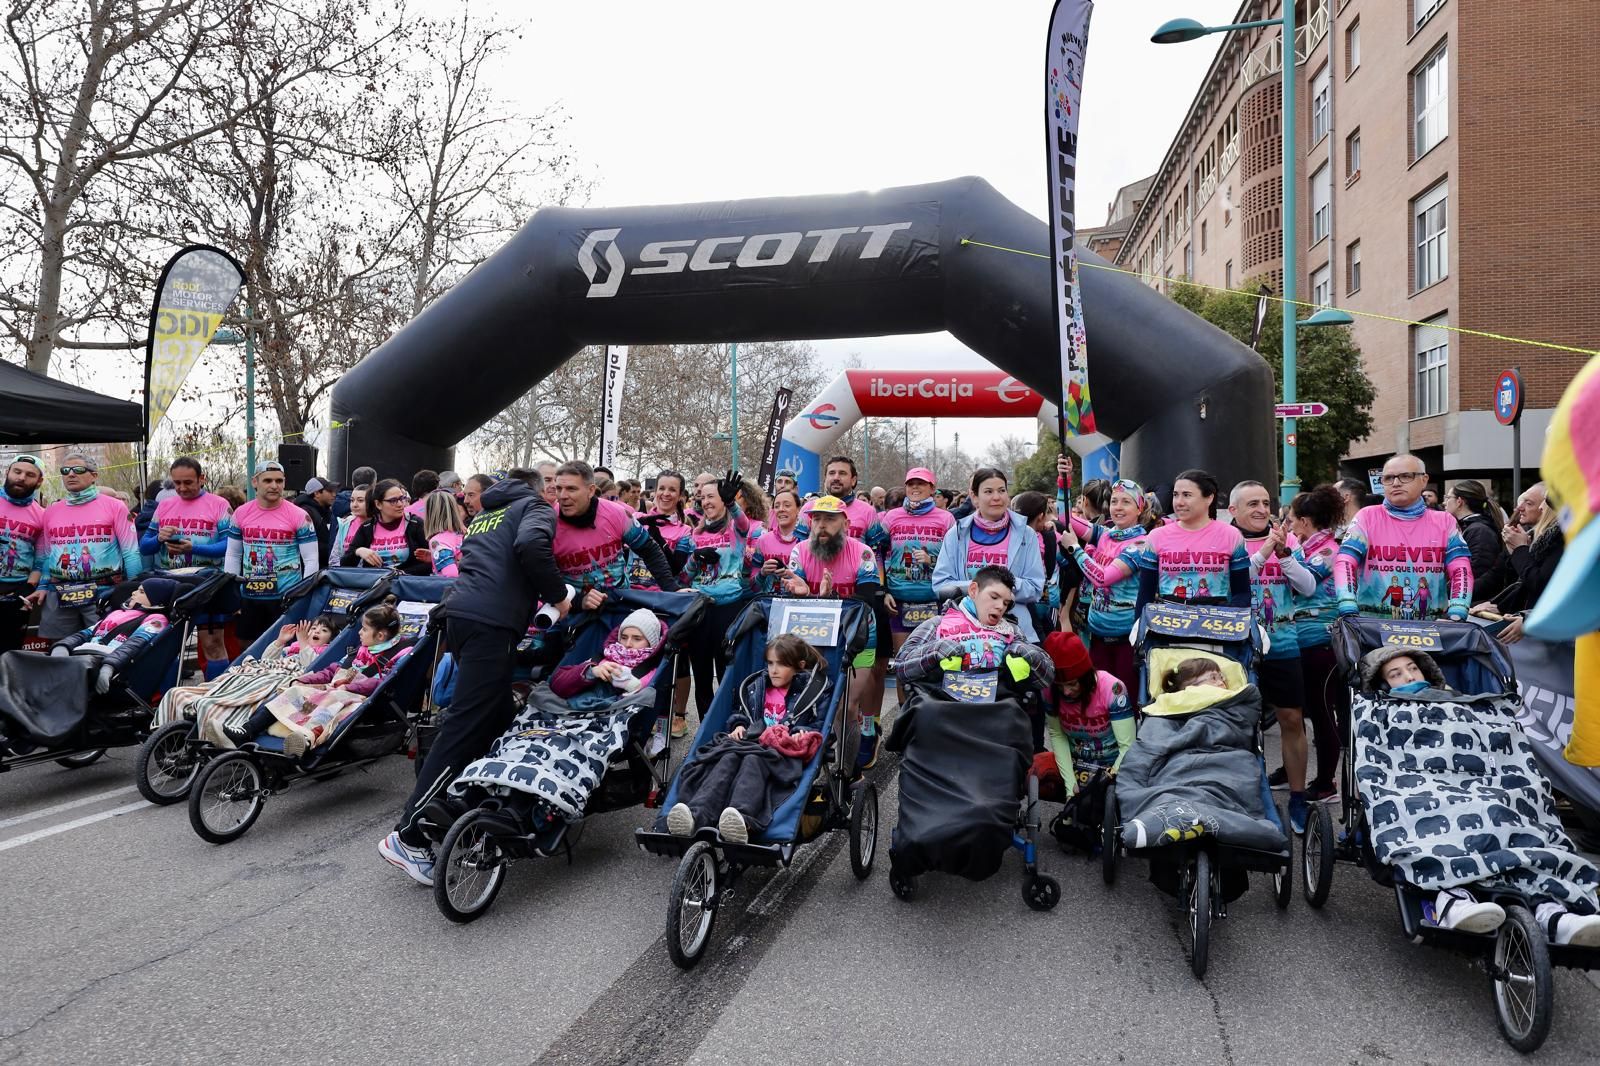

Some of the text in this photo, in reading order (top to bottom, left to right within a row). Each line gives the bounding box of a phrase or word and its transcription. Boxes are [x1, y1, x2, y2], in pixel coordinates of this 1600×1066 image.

[630, 222, 913, 276] SCOTT
[173, 280, 200, 291] RODI
[172, 289, 213, 302] MOTOR
[172, 298, 224, 311] SERVICES
[870, 377, 974, 403] iberCaja
[766, 418, 781, 465] iberCaja
[464, 514, 505, 540] STAFF
[967, 550, 1009, 565] UÉVET
[1161, 548, 1225, 565] MUÉVETE
[1395, 565, 1411, 573] QUE
[245, 581, 274, 591] 4390
[61, 589, 94, 601] 4258
[329, 598, 352, 609] 4657
[905, 610, 936, 621] 4844
[1151, 615, 1191, 629] 4557
[791, 625, 829, 637] 4546
[1201, 619, 1245, 632] 4548
[961, 634, 976, 642] QUE
[1387, 635, 1435, 647] 4780
[947, 683, 991, 698] 4455
